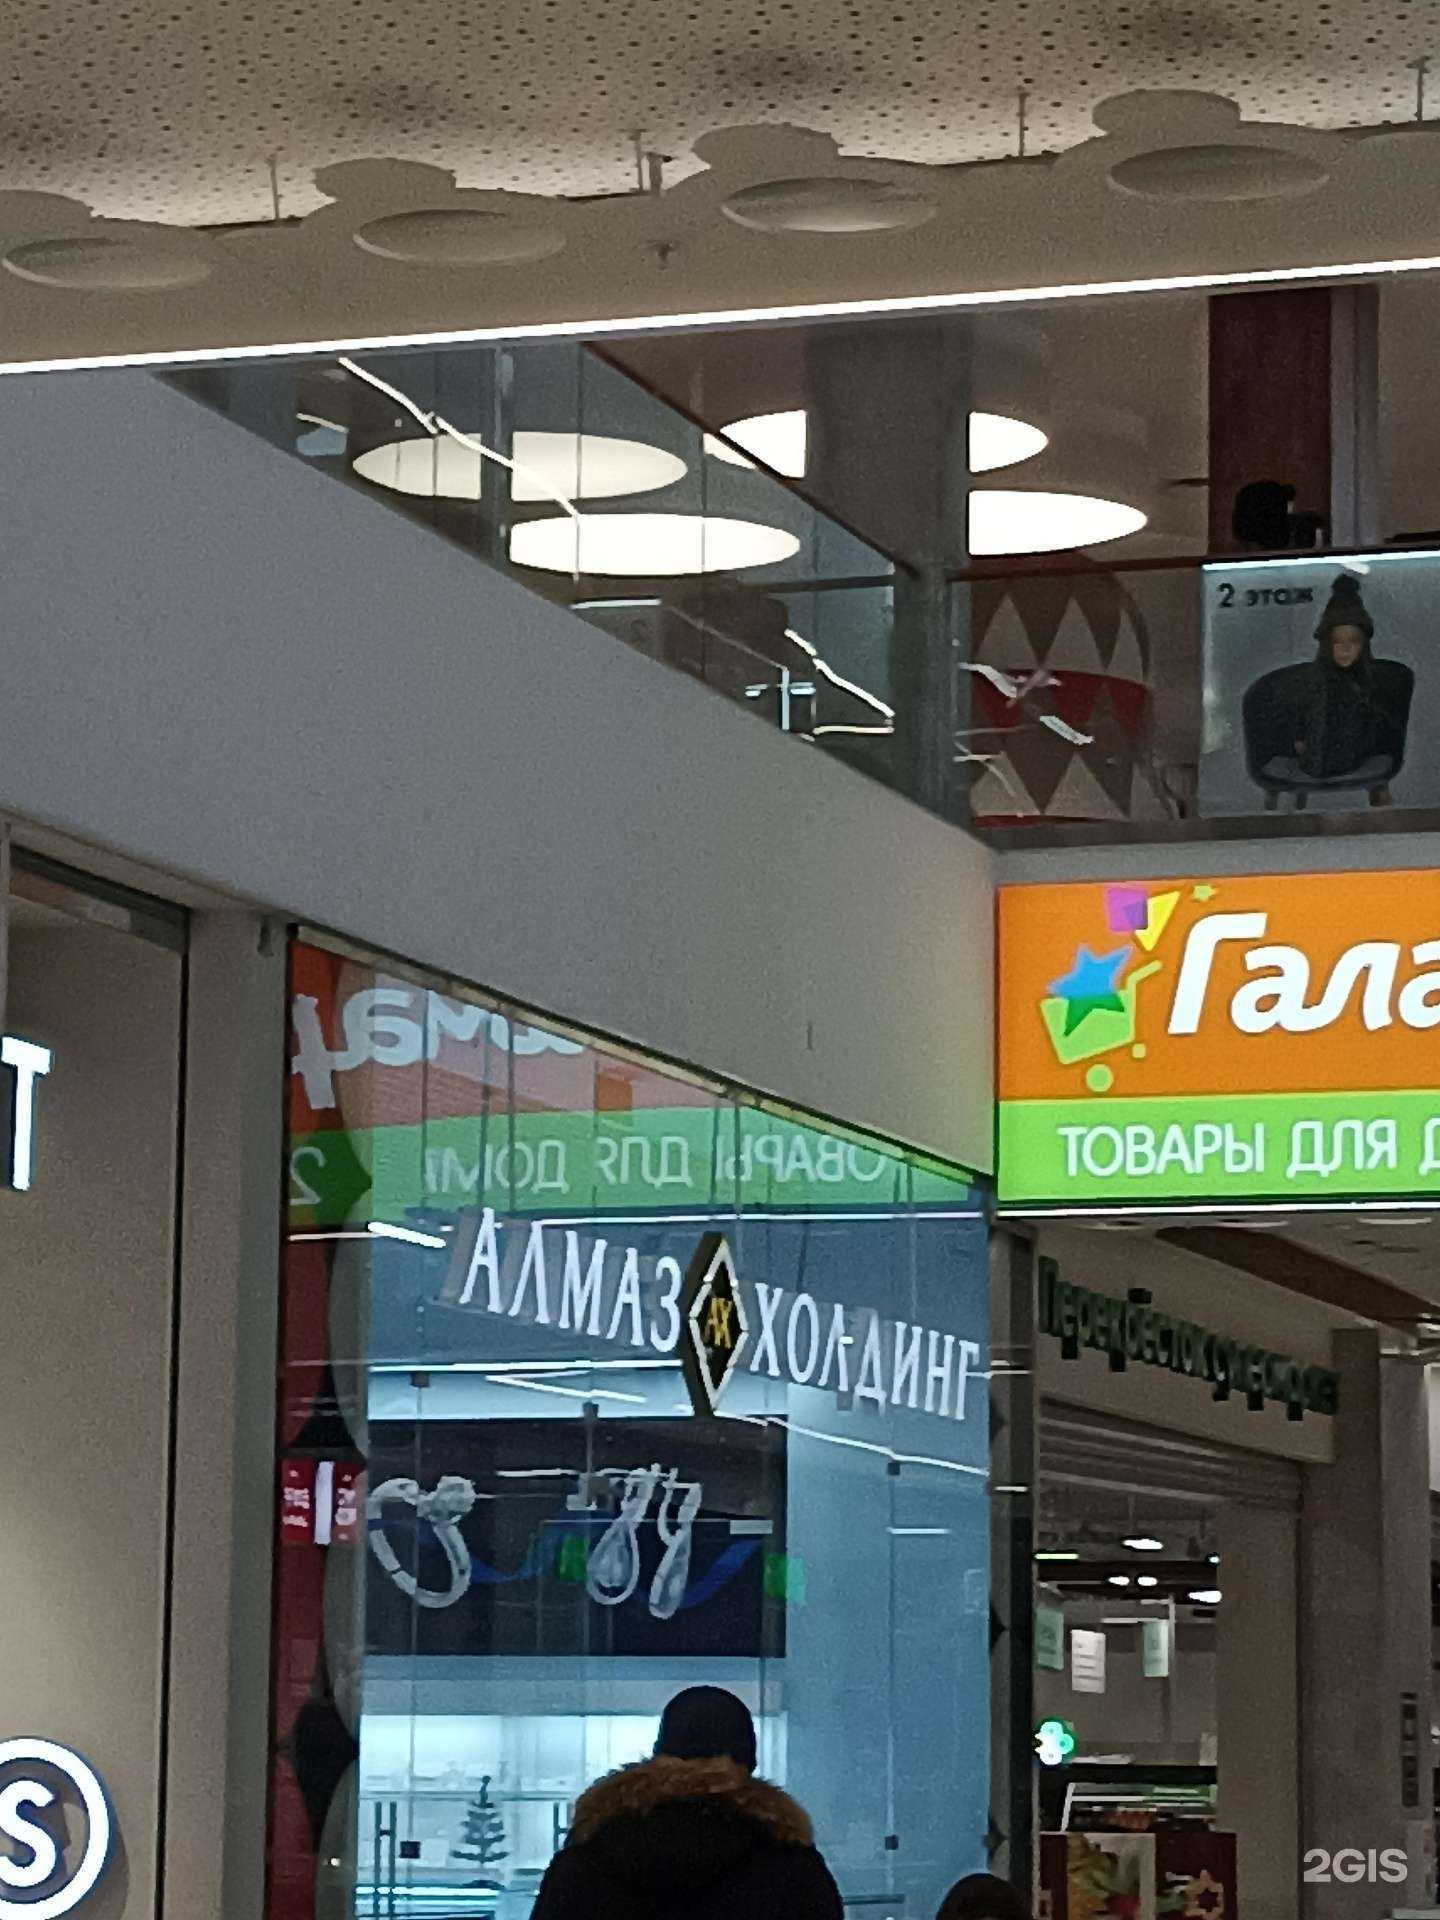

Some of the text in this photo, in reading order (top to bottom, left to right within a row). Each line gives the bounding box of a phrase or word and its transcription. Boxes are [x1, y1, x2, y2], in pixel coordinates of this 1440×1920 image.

[1217, 583, 1235, 607] 2
[1057, 1123, 1265, 1177] ТОВАРЫ
[1286, 1119, 1398, 1179] ДЛЯ
[458, 1206, 683, 1353] АЛМАЗ
[750, 1282, 979, 1421] ХОЛДИНГ
